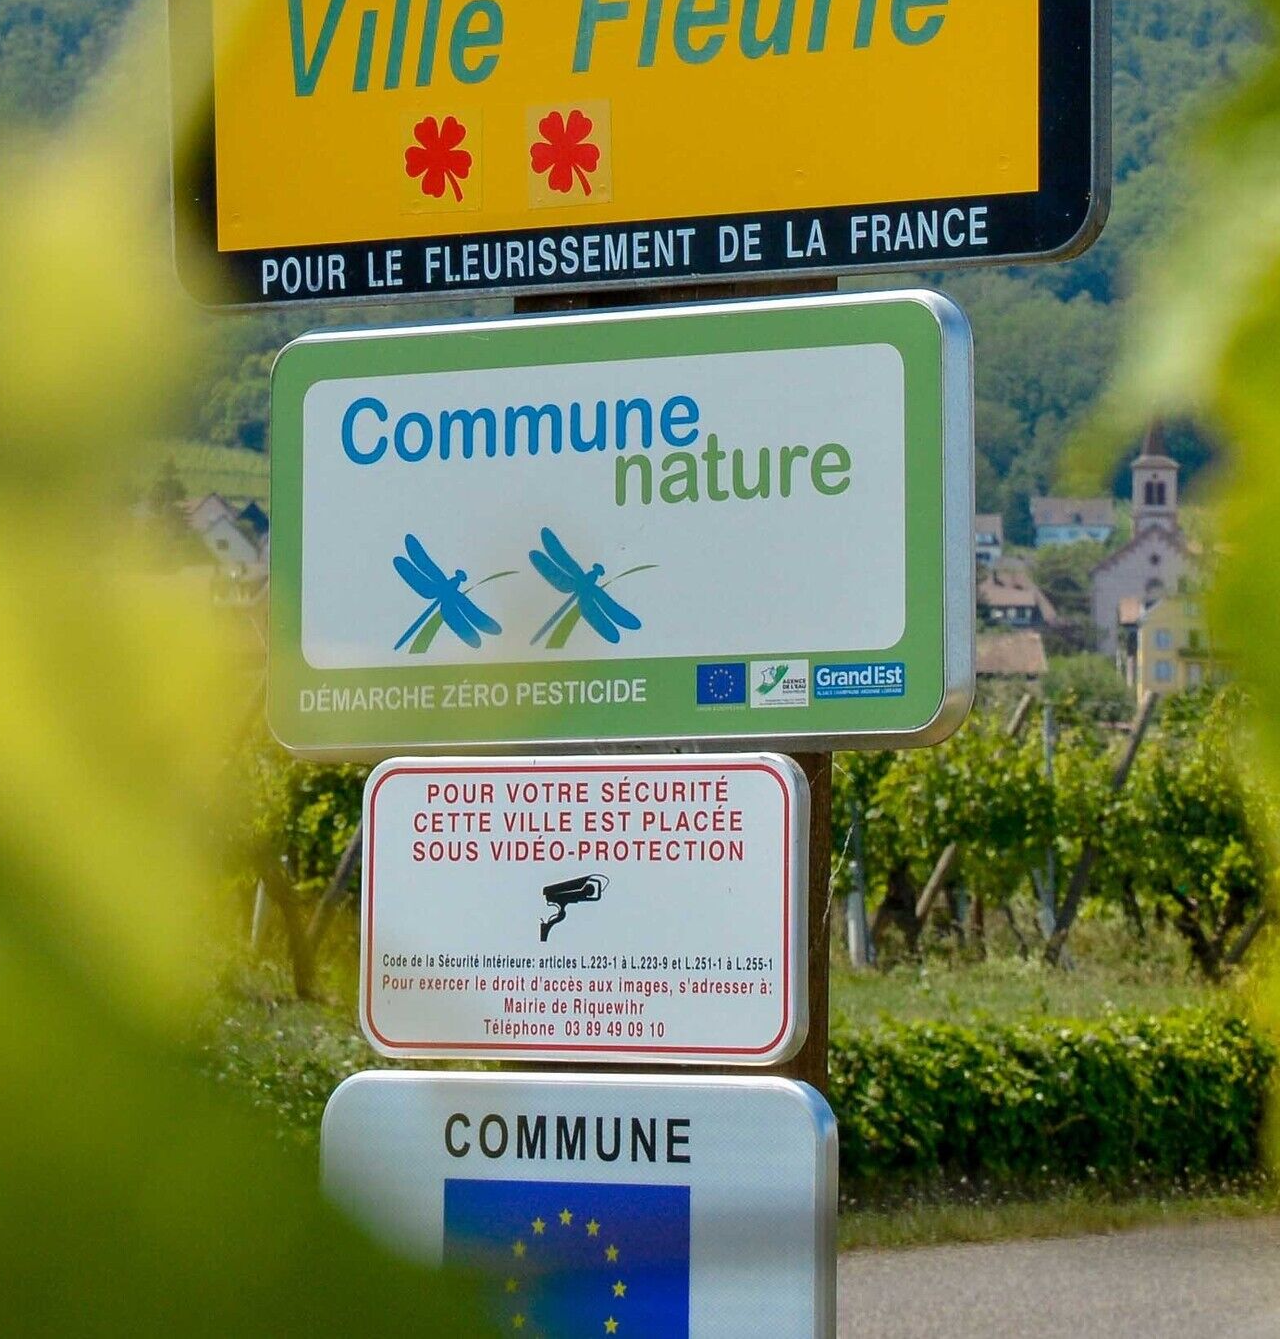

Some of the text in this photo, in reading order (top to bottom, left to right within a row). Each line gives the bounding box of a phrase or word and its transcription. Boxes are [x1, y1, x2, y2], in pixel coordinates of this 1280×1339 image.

[261, 206, 988, 295] POUR LE FLEURISSEMENT DE LA FRANCE
[341, 394, 699, 465] Commune
[615, 433, 851, 507] nature
[299, 679, 647, 712] DÉMARCHE ZÉRO PESTICIDE
[427, 775, 729, 804] POUR VOTRE SÉCURITÉ
[413, 805, 743, 833] CETTE VILLE EST PLACÉE
[413, 835, 744, 862] SOUS VIDÉO-PROTECTION
[383, 954, 773, 971] Code de la Sécurité Intérieure: articles L.223-1 à L.223-9 et L.251-1 à L.255-1
[382, 974, 773, 997] Pour exercer le droit d'accès aux images, s'adresser à:
[504, 998, 645, 1018] Mairie de Riquewihr
[483, 1019, 665, 1039] Téléphone 03 89 49 09 10
[444, 1113, 691, 1163] COMMUNE
